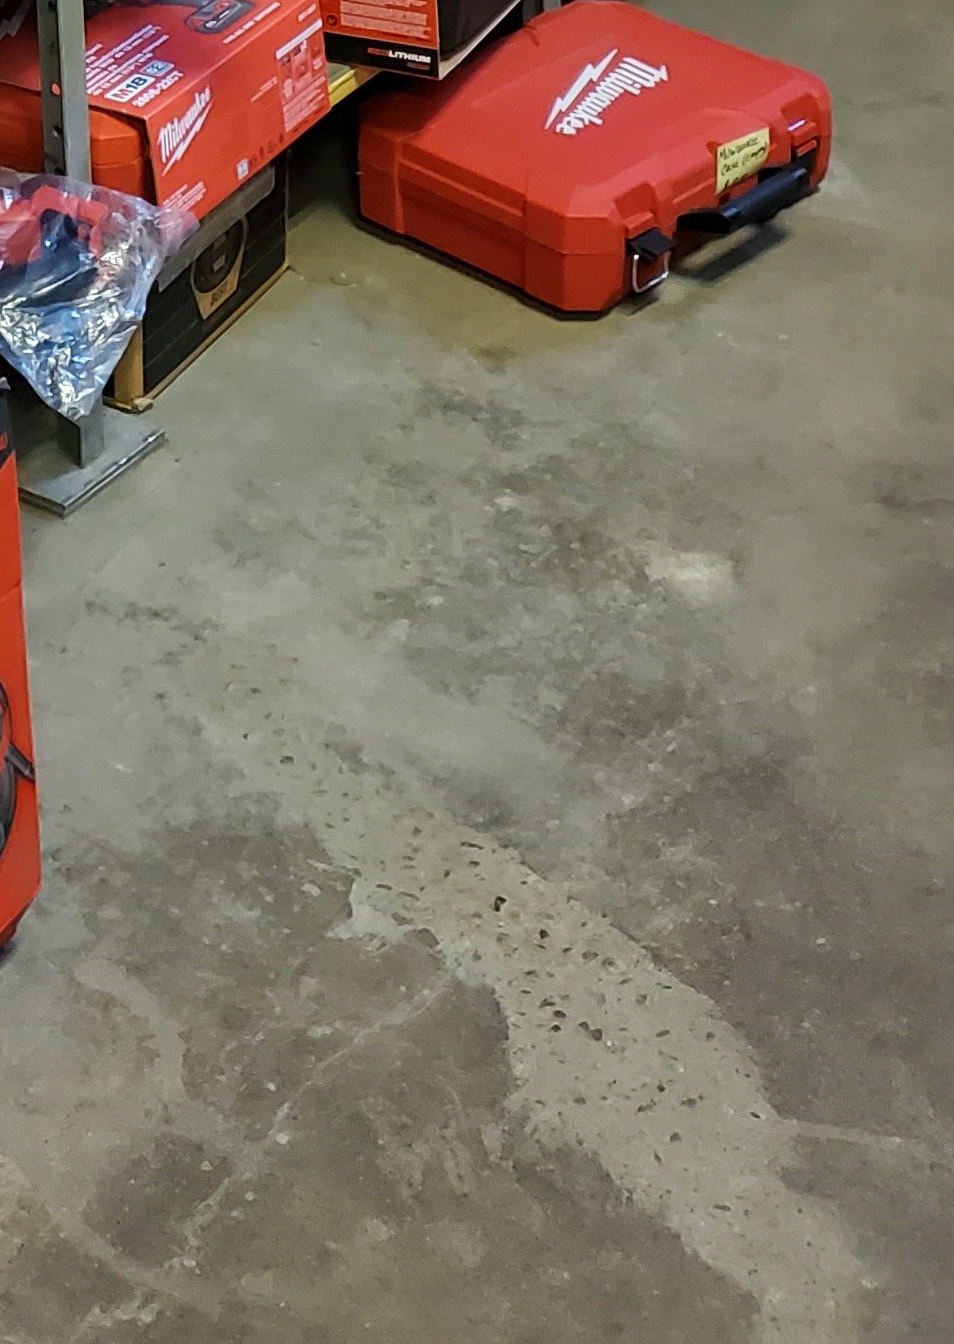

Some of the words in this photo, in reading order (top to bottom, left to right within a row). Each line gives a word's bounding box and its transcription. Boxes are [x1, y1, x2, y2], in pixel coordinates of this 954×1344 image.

[113, 75, 147, 101] M18
[159, 86, 212, 165] Milwaukee
[555, 56, 669, 136] Milwaukee
